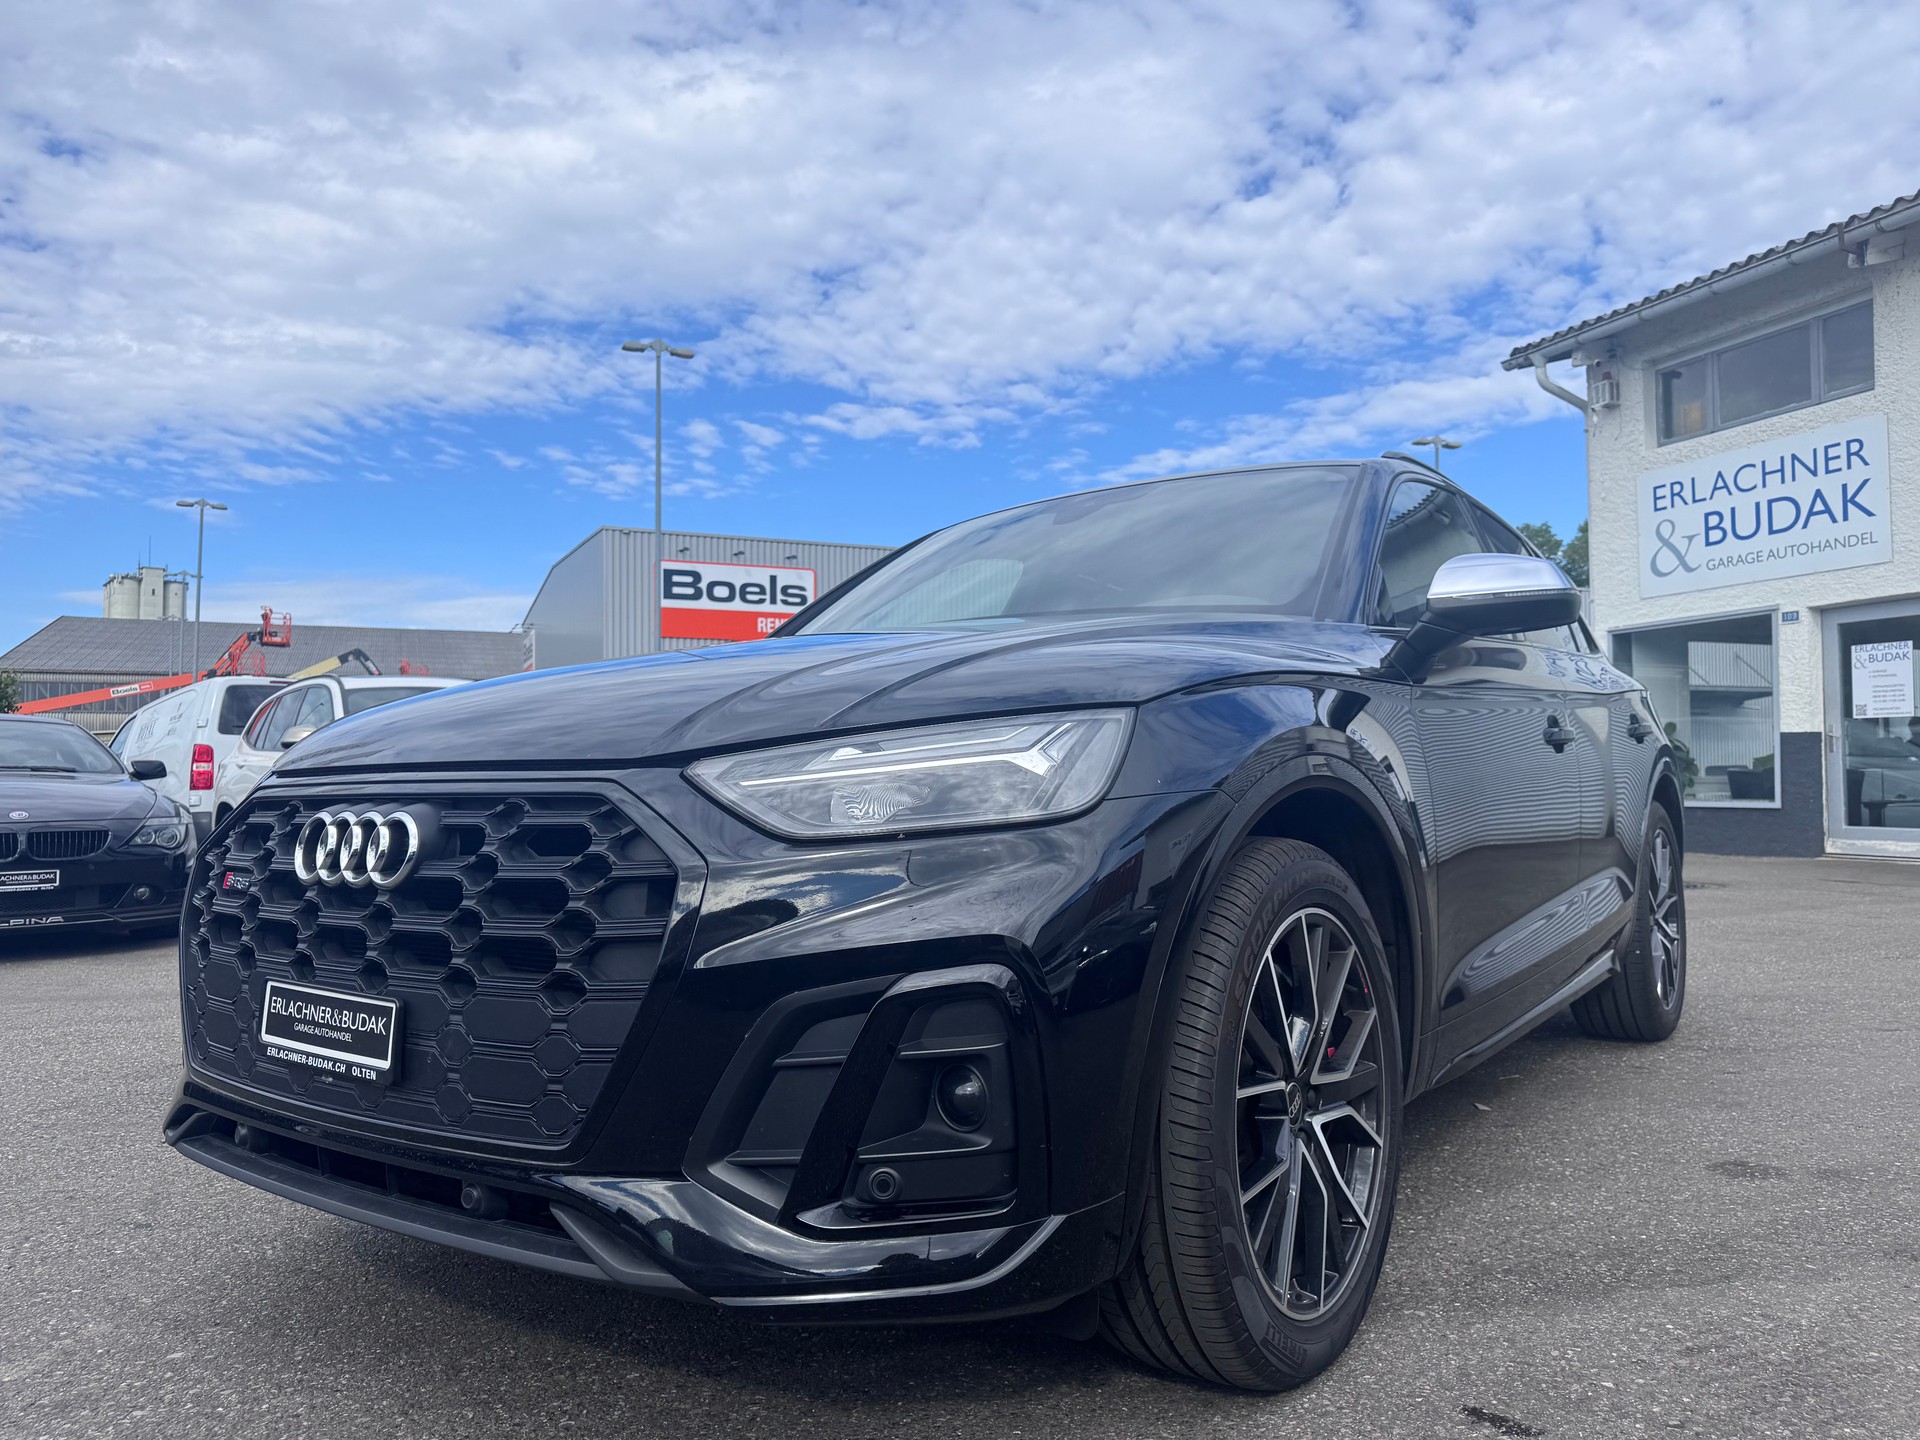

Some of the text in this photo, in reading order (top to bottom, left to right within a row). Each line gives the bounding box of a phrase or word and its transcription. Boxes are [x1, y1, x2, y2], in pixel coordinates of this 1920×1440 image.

[1653, 438, 1870, 512] ERLACHNER
[1650, 478, 1877, 578] & BUDAK
[1706, 531, 1878, 571] GARAGE AUTOHANDEL
[663, 568, 808, 606] Boels
[1854, 641, 1910, 654] ERLACHNER
[1854, 651, 1911, 670] & BUDAK
[0, 873, 55, 881] ACHNER&BUDAK
[270, 996, 387, 1036] ERLACHNER&BUDAK
[293, 1022, 353, 1043] GARAGE AUTOHANDEL
[266, 1046, 377, 1081] ERLACHNER-BUDAK.CH OLTEN
